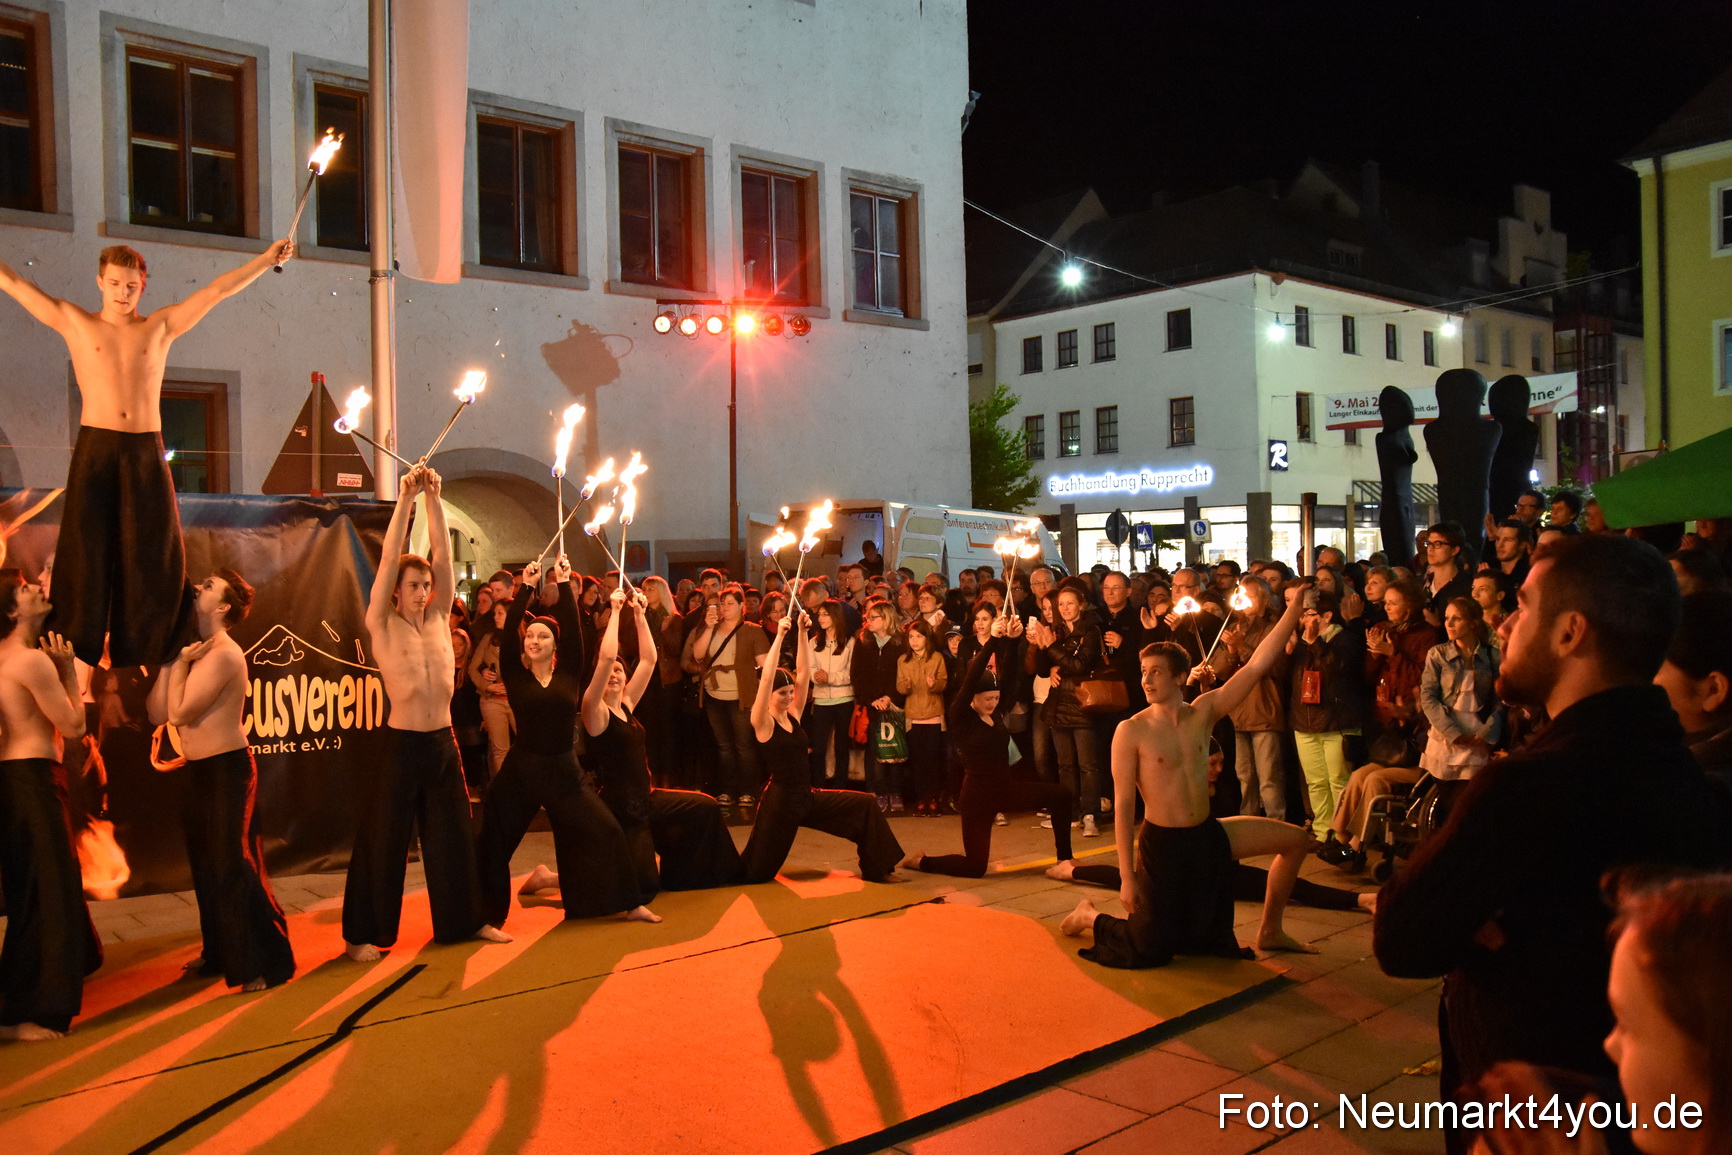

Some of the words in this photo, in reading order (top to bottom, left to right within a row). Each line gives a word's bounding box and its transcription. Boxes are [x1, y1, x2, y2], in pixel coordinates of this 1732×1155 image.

[1329, 409, 1352, 419] Langer
[1353, 408, 1381, 417] Einkauf
[1426, 404, 1438, 412] der
[1334, 399, 1345, 409] 9.
[1348, 397, 1369, 408] Mai
[1372, 396, 1380, 407] 2
[1271, 443, 1288, 467] R
[1050, 474, 1136, 493] Buchhandlung
[1141, 468, 1208, 489] Rupprecht
[945, 518, 1008, 532] onferenztechnik.de
[242, 674, 383, 738] cusverein
[881, 722, 895, 741] D
[249, 740, 296, 755] markt
[301, 737, 330, 751] e.V.
